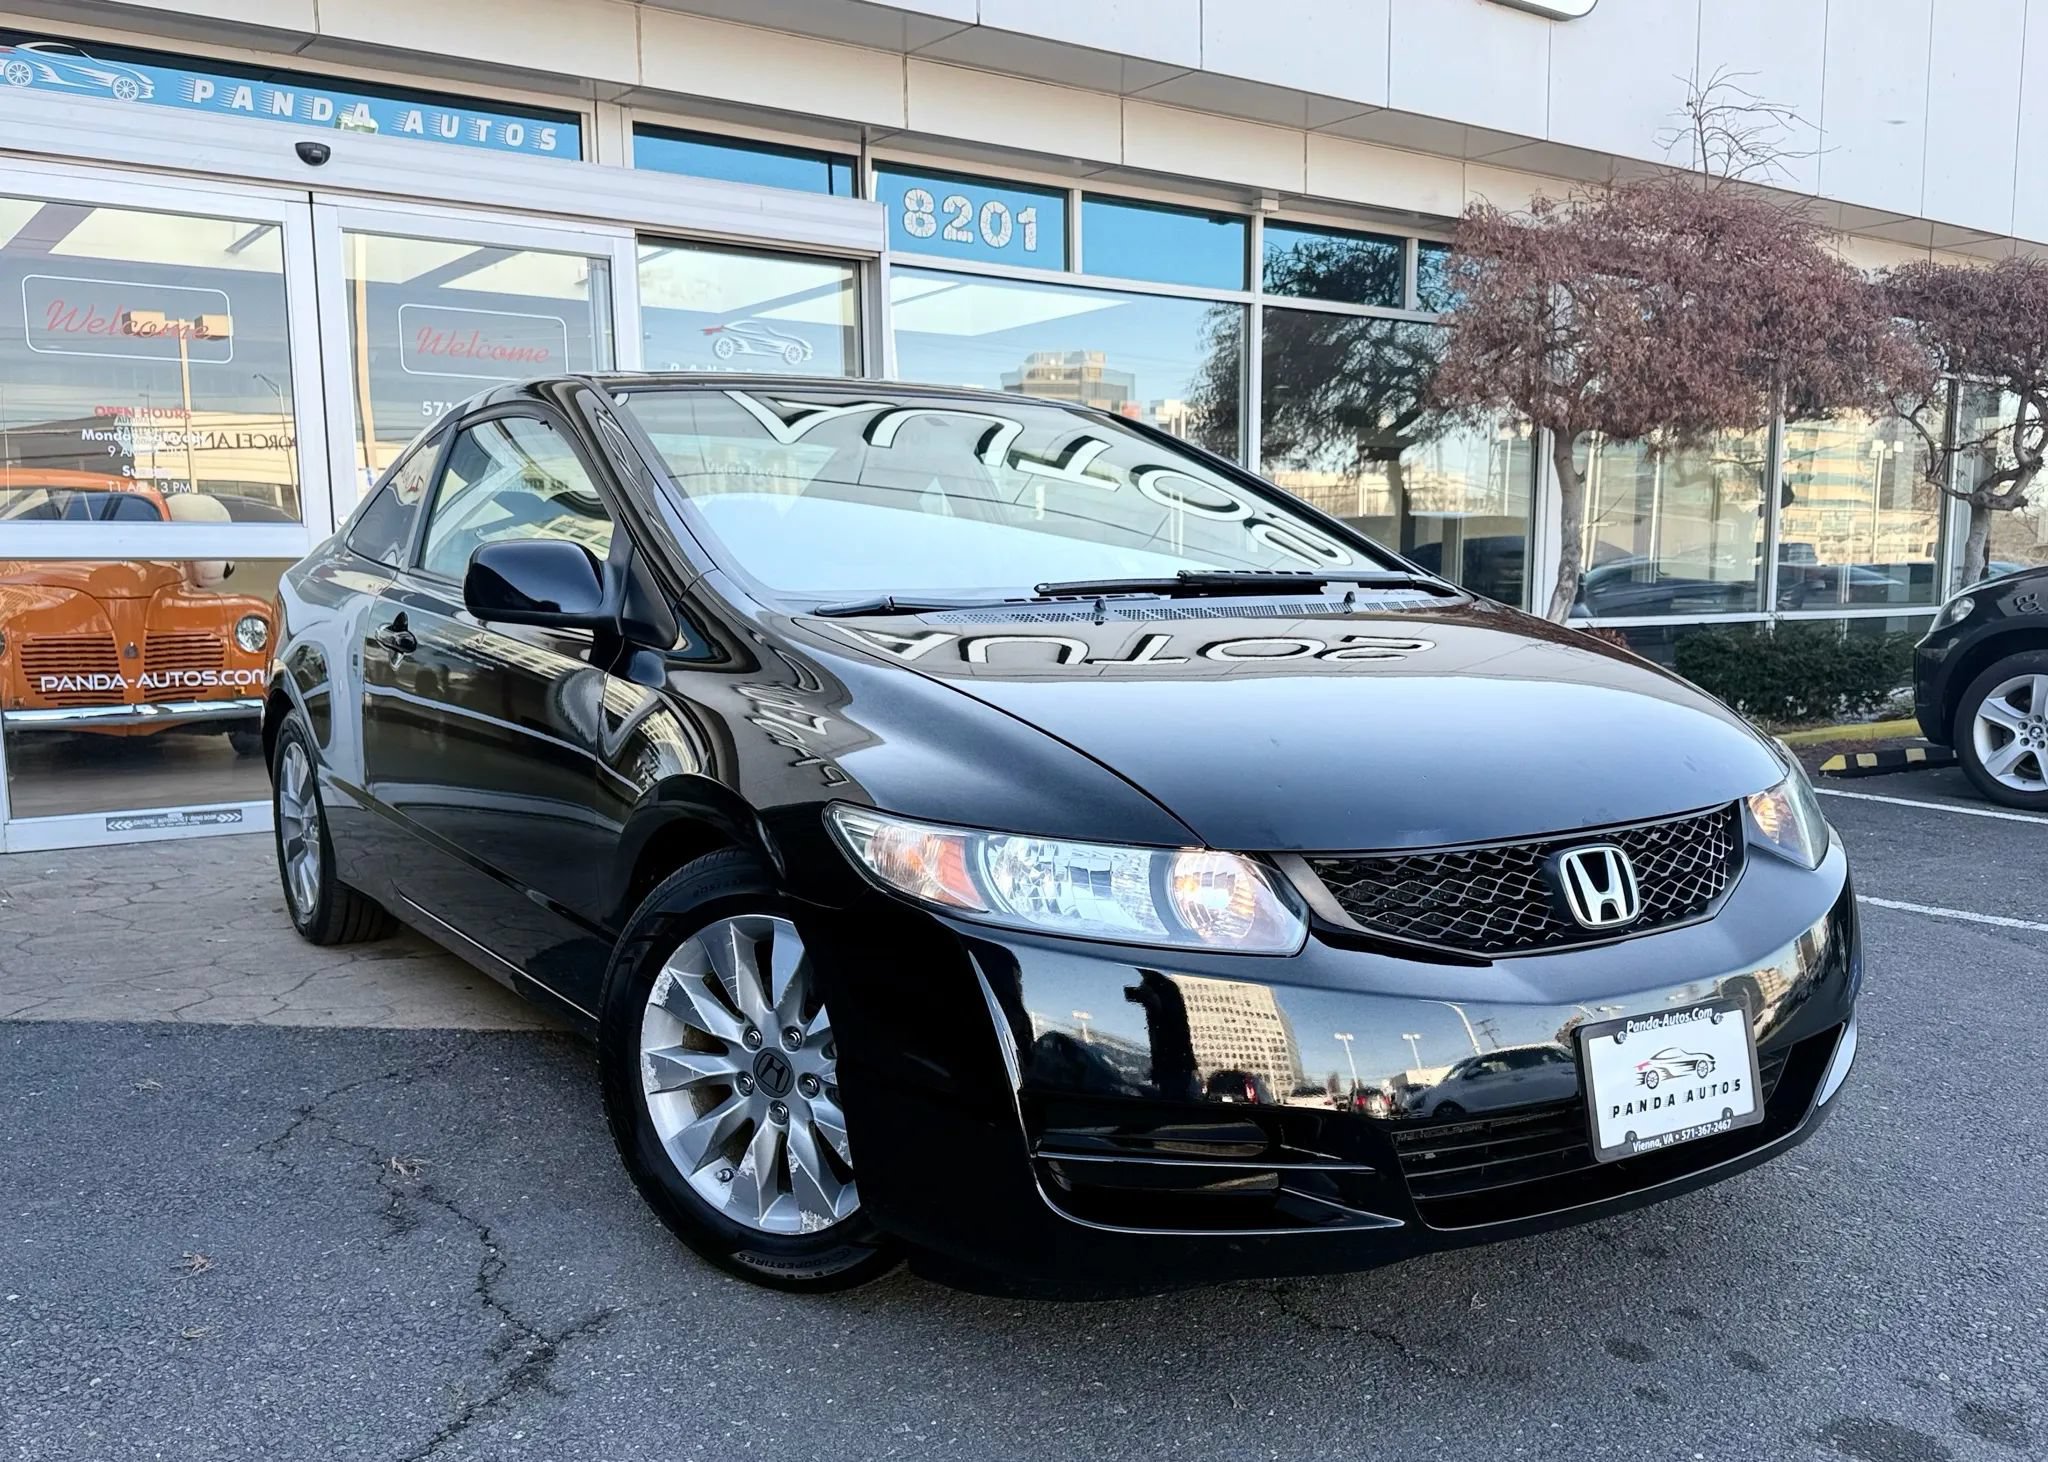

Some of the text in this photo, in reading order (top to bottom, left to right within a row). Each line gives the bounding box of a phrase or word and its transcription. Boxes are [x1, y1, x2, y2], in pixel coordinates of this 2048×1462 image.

[188, 78, 557, 151] PANDA AUTOS
[902, 187, 1039, 252] 8201
[47, 299, 213, 341] Welcome
[416, 325, 551, 364] Welcome
[94, 405, 192, 420] OPEN HOURS
[160, 482, 168, 493] 3
[172, 482, 191, 493] PM
[1626, 1007, 1713, 1034] Panda-Autos.Com
[1612, 1078, 1741, 1119] PANDA AUTOS
[1632, 1119, 1732, 1152] Vienna, VA 571-367-2467
